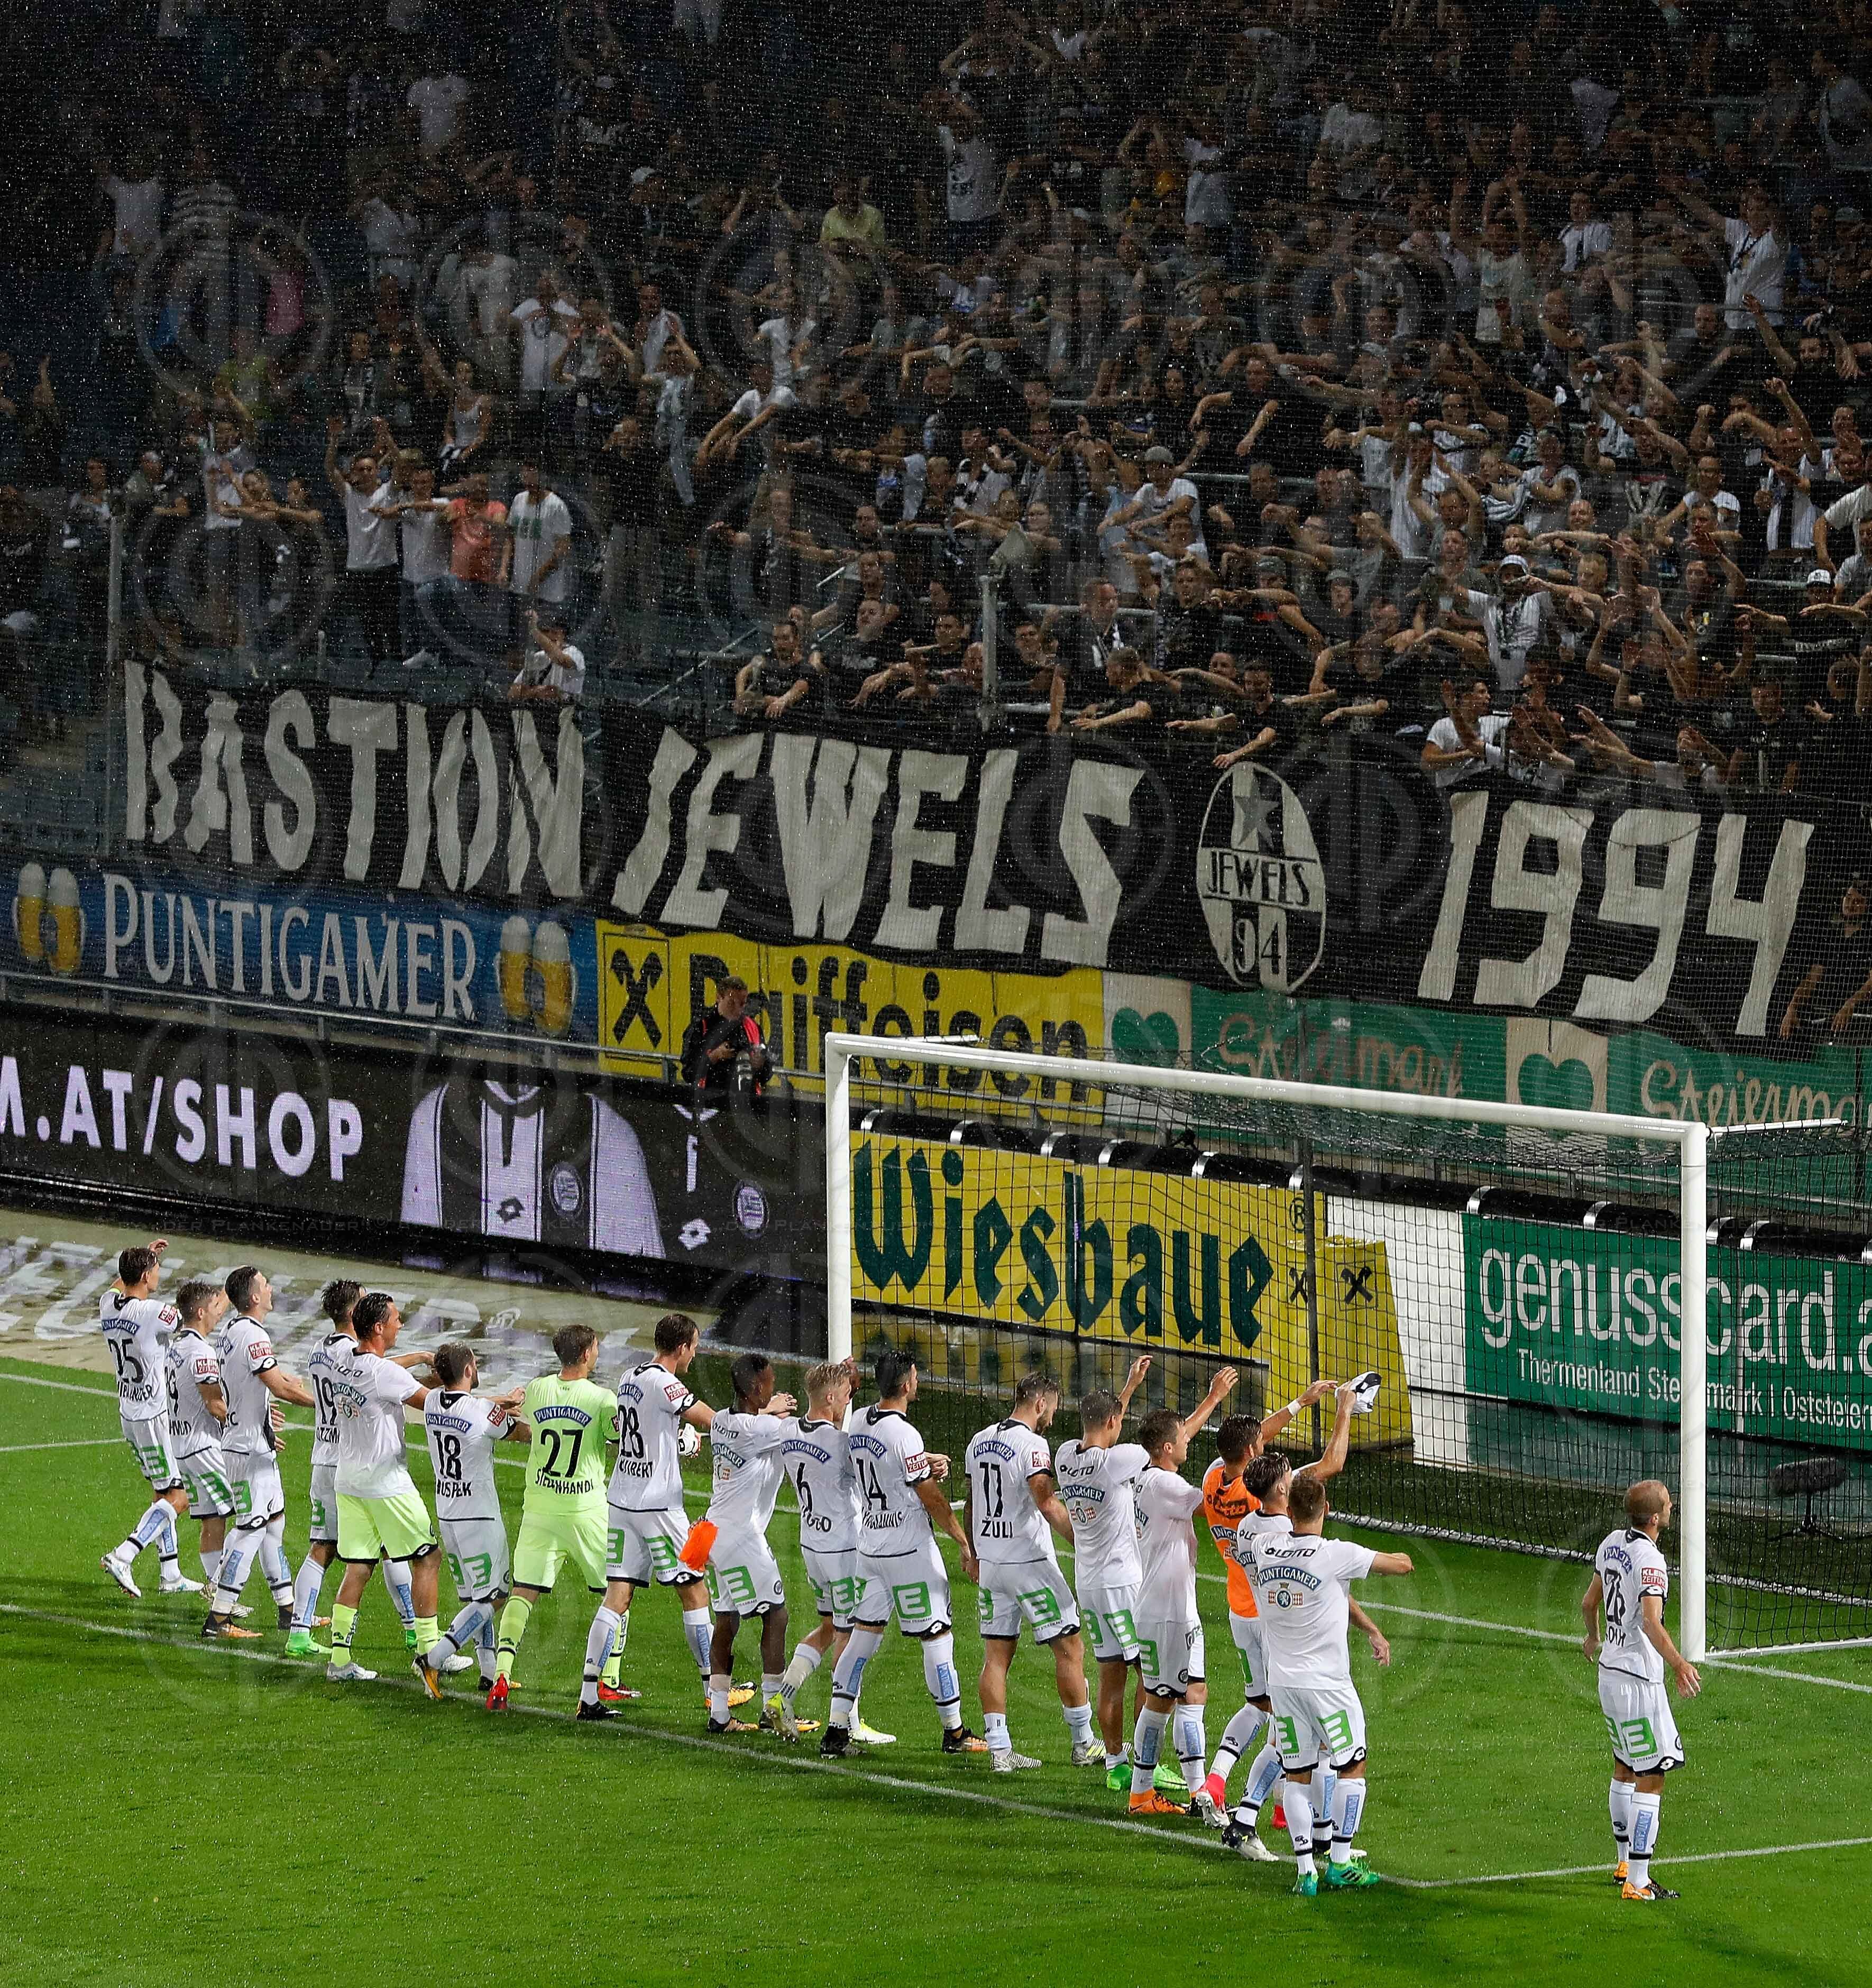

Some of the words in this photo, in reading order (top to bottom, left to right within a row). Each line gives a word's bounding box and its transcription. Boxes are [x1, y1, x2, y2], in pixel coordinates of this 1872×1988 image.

[125, 660, 584, 898] BASTION
[611, 726, 1145, 967] JEWELS
[1206, 849, 1310, 907] JEWELS
[1417, 790, 1815, 1037] 1994
[104, 873, 476, 1021] PUNTIGAMER
[1231, 917, 1283, 977] 94
[1641, 1060, 1872, 1127] Steierma
[536, 1407, 590, 1425] PUNTIGAMER
[1516, 1348, 1639, 1397] Thermenland
[1783, 1386, 1872, 1431] Oststeier
[433, 1430, 462, 1481] 18
[540, 1428, 584, 1478] 27
[618, 1404, 644, 1459] 28
[781, 1441, 828, 1462] PUNTIGAMER
[856, 1457, 888, 1511] 14
[1259, 1566, 1320, 1590] PUNTIGAMER
